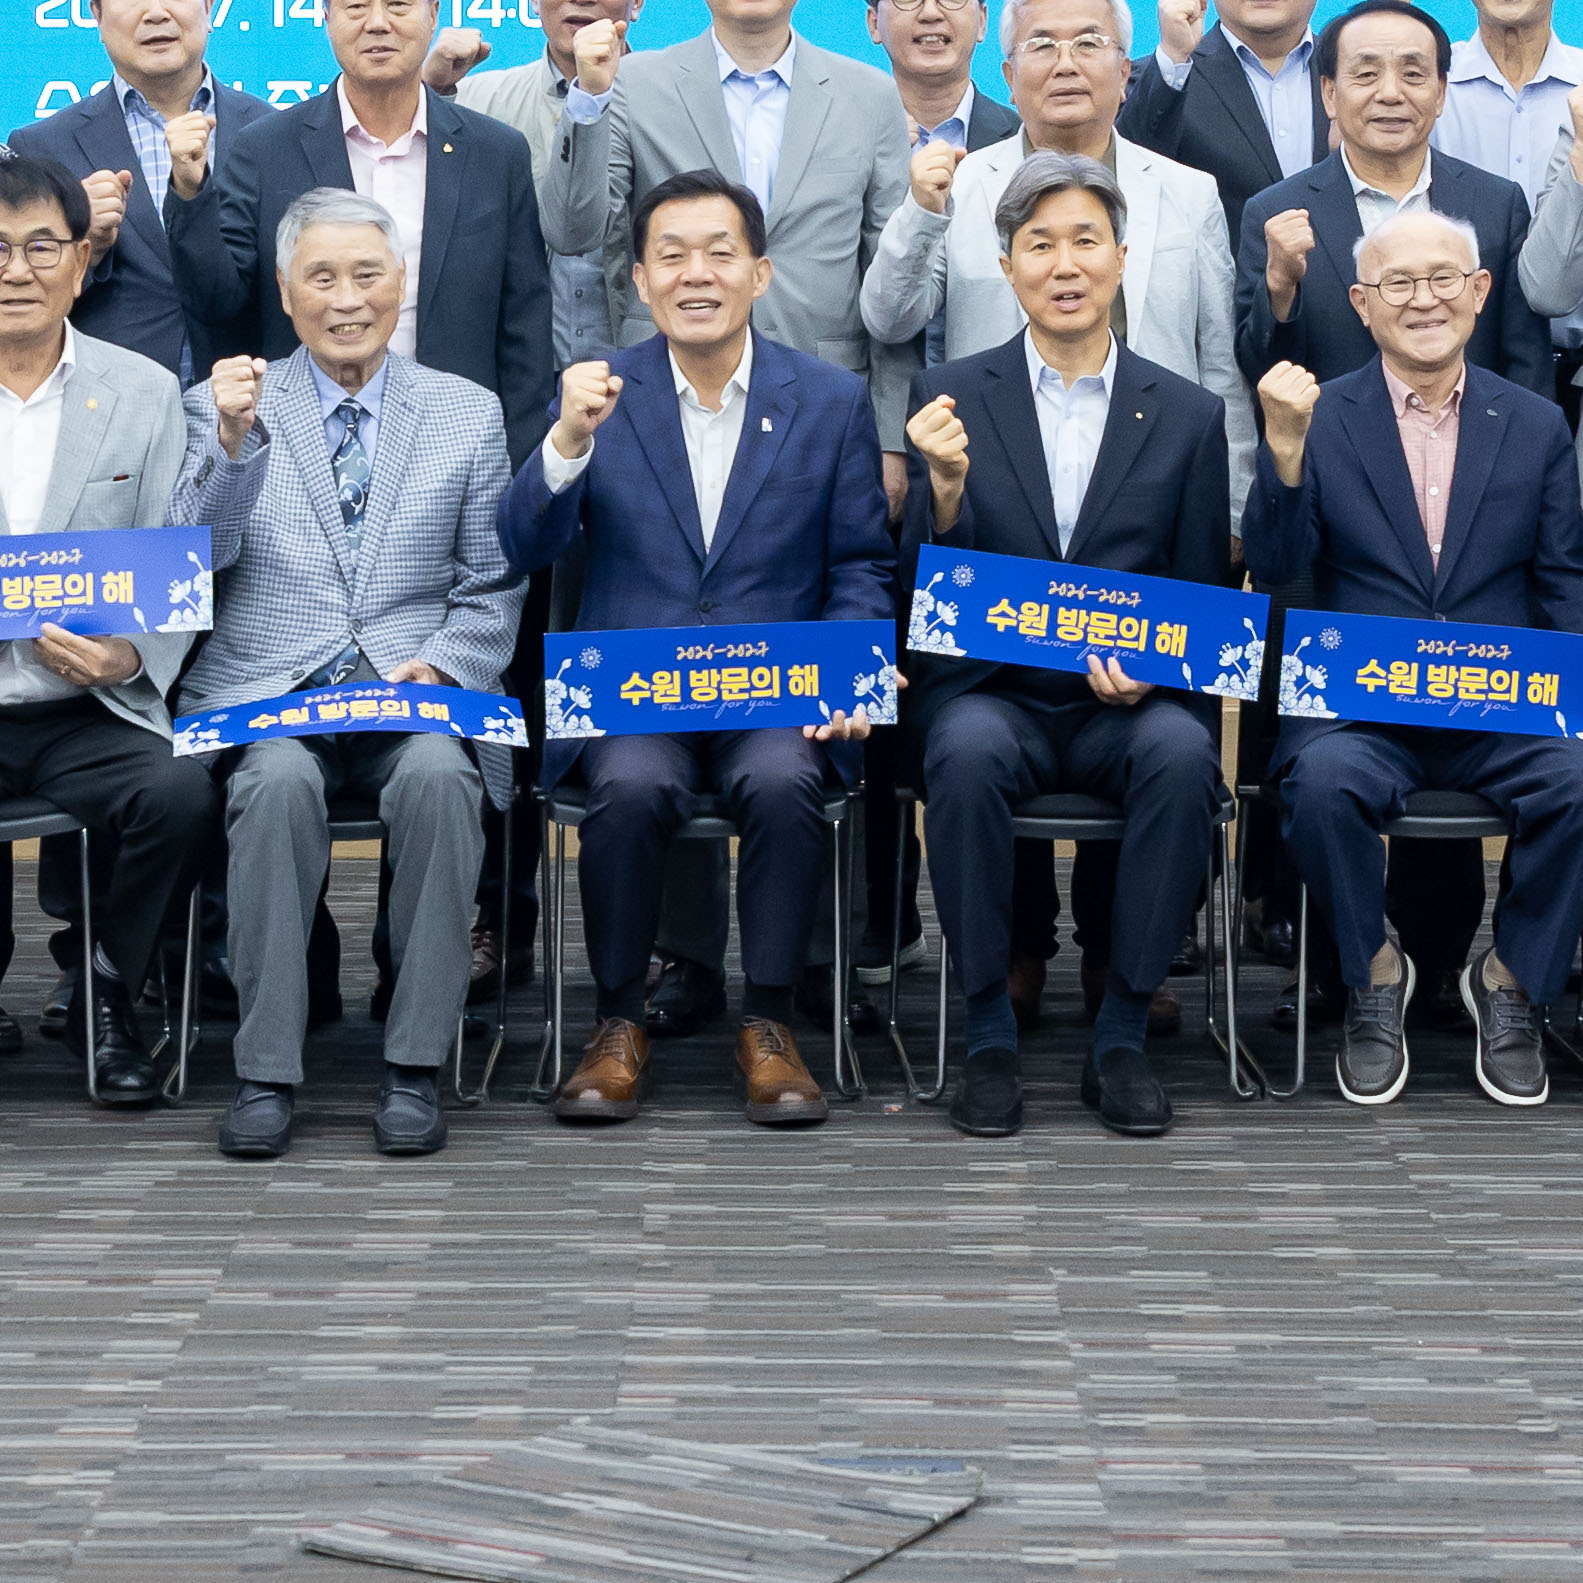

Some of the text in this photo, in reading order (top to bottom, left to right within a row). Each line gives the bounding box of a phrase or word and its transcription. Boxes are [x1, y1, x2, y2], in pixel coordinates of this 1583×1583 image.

[2, 572, 94, 609] 방문의
[101, 571, 134, 604] 해
[986, 598, 1188, 658] 수원 방문의 해
[620, 664, 819, 705] 수원 방문의 해
[1356, 658, 1560, 706] 수원 방문의 해
[248, 707, 310, 729] 수원
[318, 700, 411, 720] 방문의
[417, 701, 450, 721] 해
